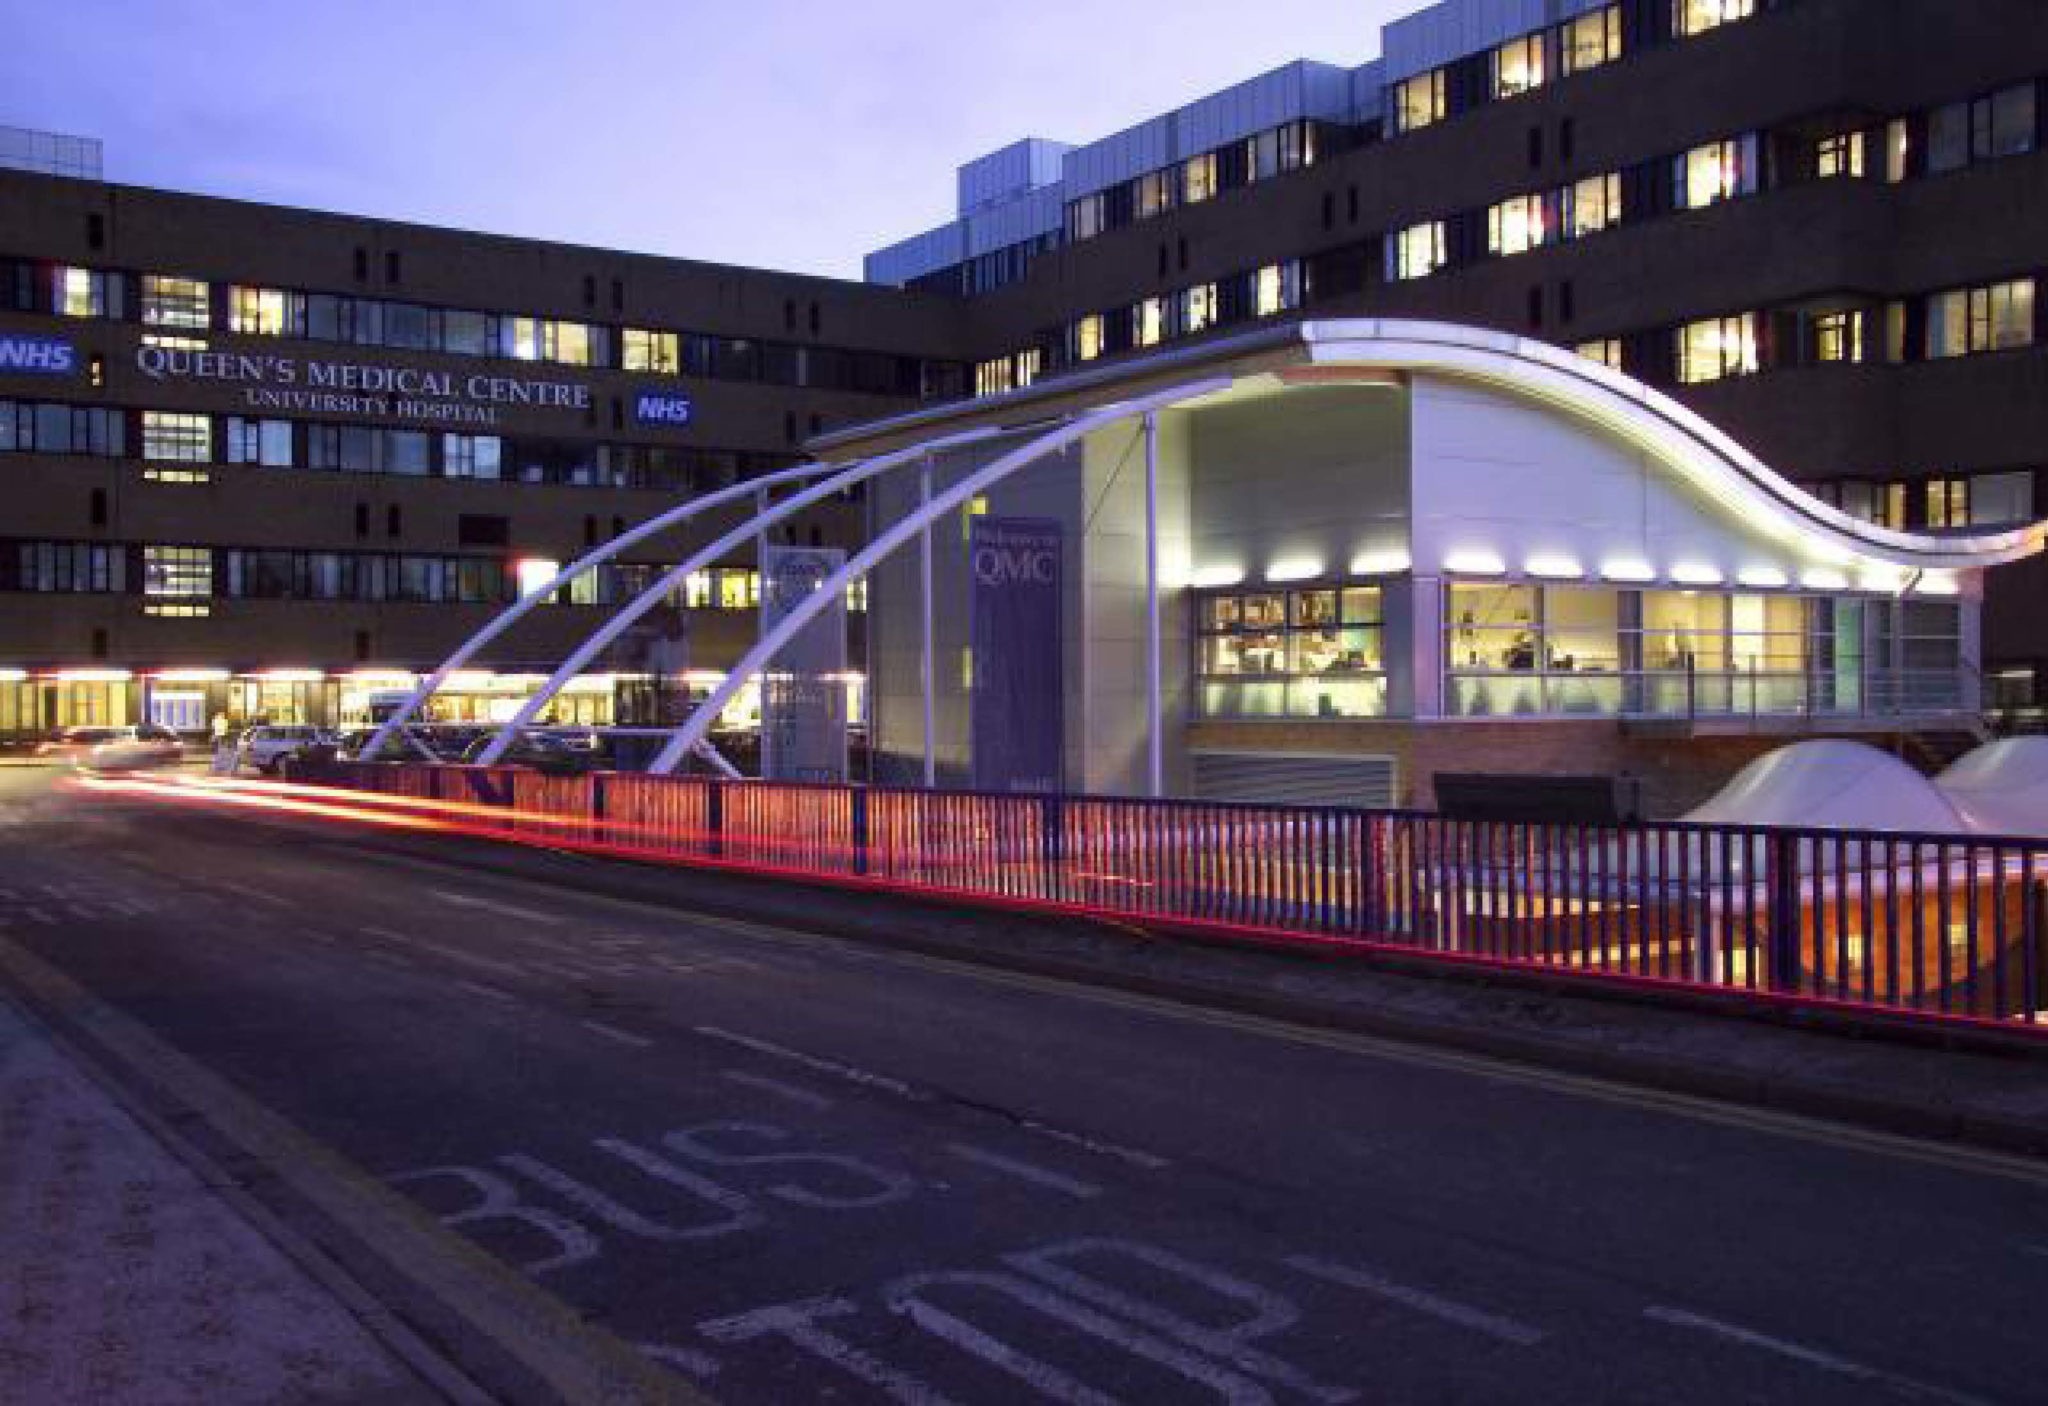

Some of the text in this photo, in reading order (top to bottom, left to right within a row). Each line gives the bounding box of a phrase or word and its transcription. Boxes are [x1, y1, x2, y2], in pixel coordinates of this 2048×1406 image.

[0, 337, 73, 369] NHS
[137, 347, 590, 408] QUEEN'S MEDICAL CENTRE
[245, 389, 495, 424] UNIVERSITY HOSPITAL
[637, 397, 691, 421] NHS
[975, 548, 1055, 585] QMC
[385, 1121, 917, 1277] BUS
[640, 1237, 1362, 1406] TOP
